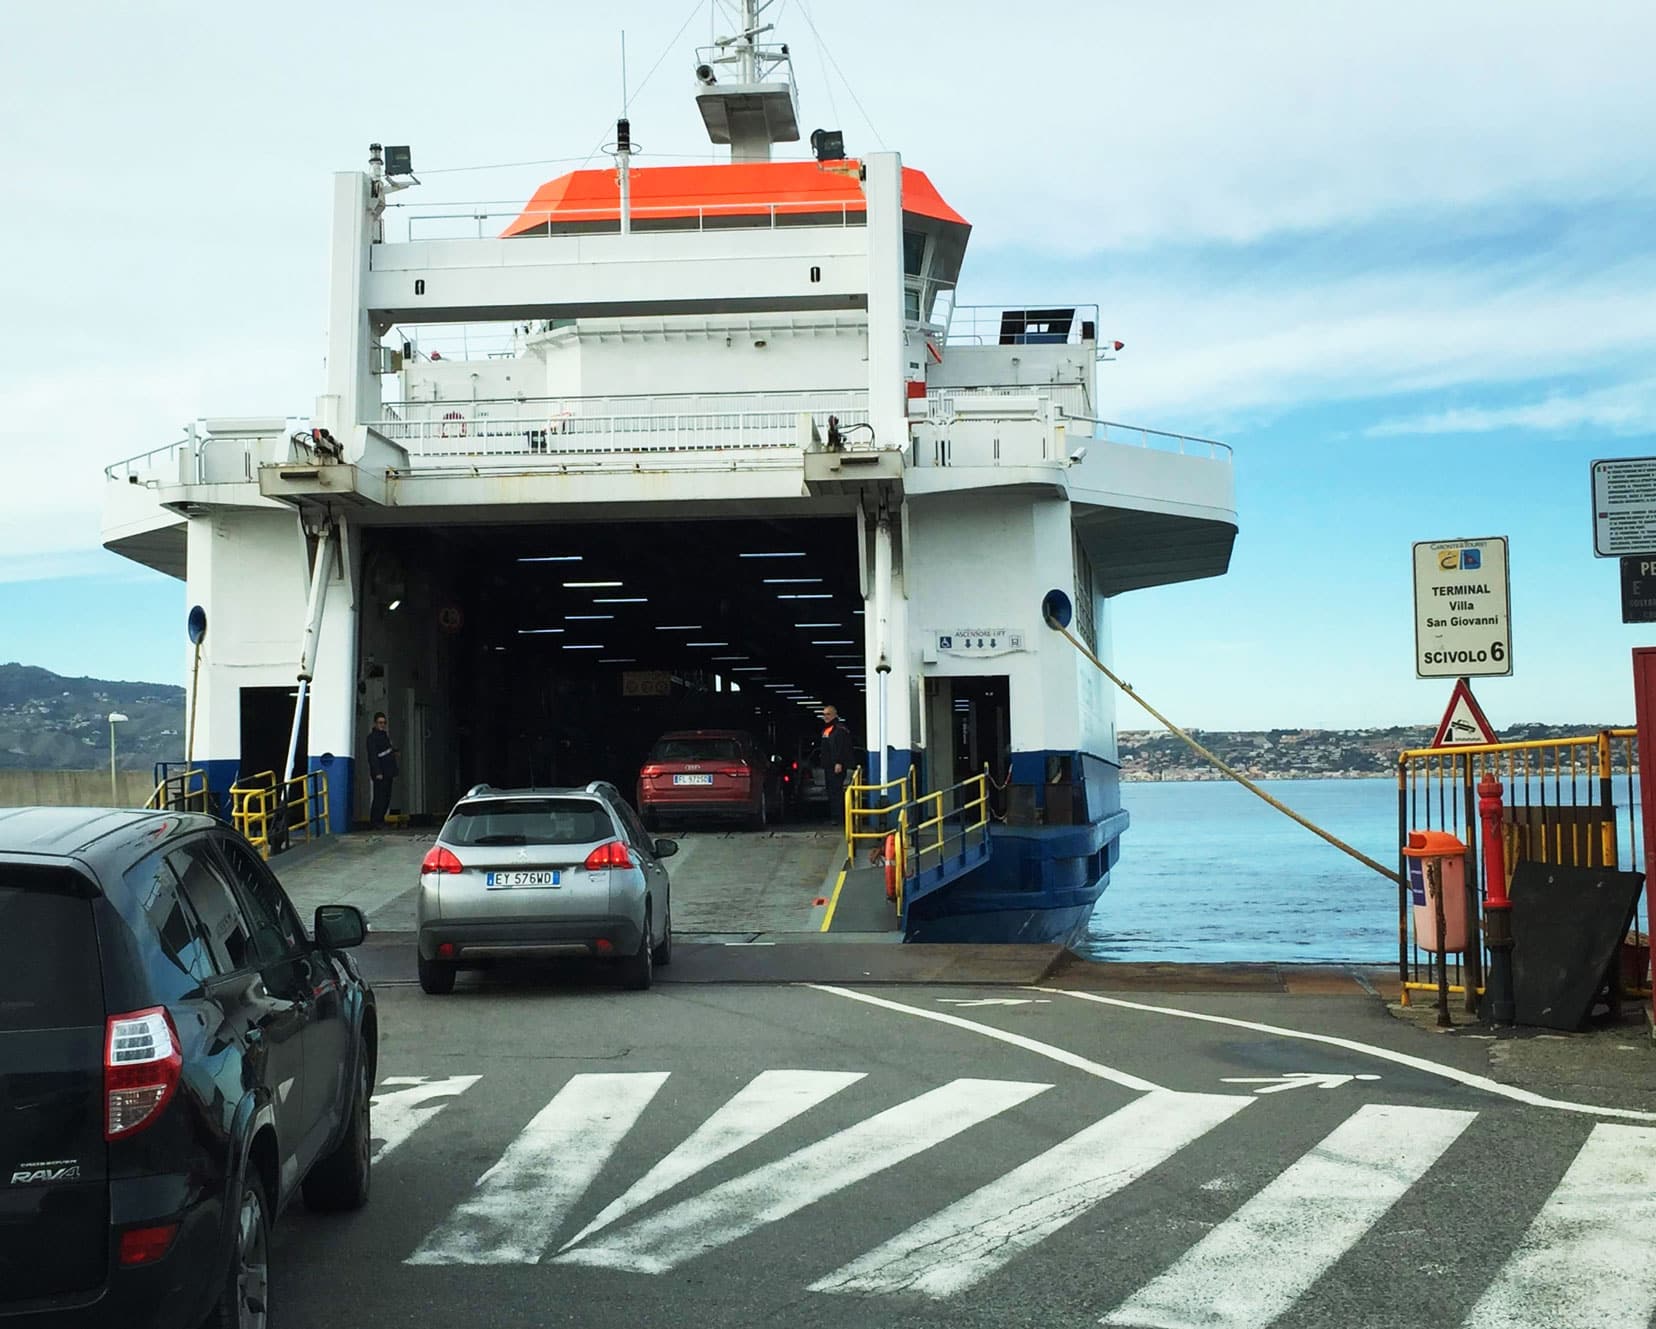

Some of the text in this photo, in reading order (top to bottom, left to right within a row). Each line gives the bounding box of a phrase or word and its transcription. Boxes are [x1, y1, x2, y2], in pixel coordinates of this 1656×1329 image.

[1432, 584, 1490, 596] TERMINAL
[1449, 601, 1474, 611] Villa
[1426, 615, 1498, 627] San Giovanni
[1424, 641, 1505, 664] SCIVOLO 6
[496, 872, 551, 885] EY 576WD
[10, 1166, 80, 1184] RAV4
